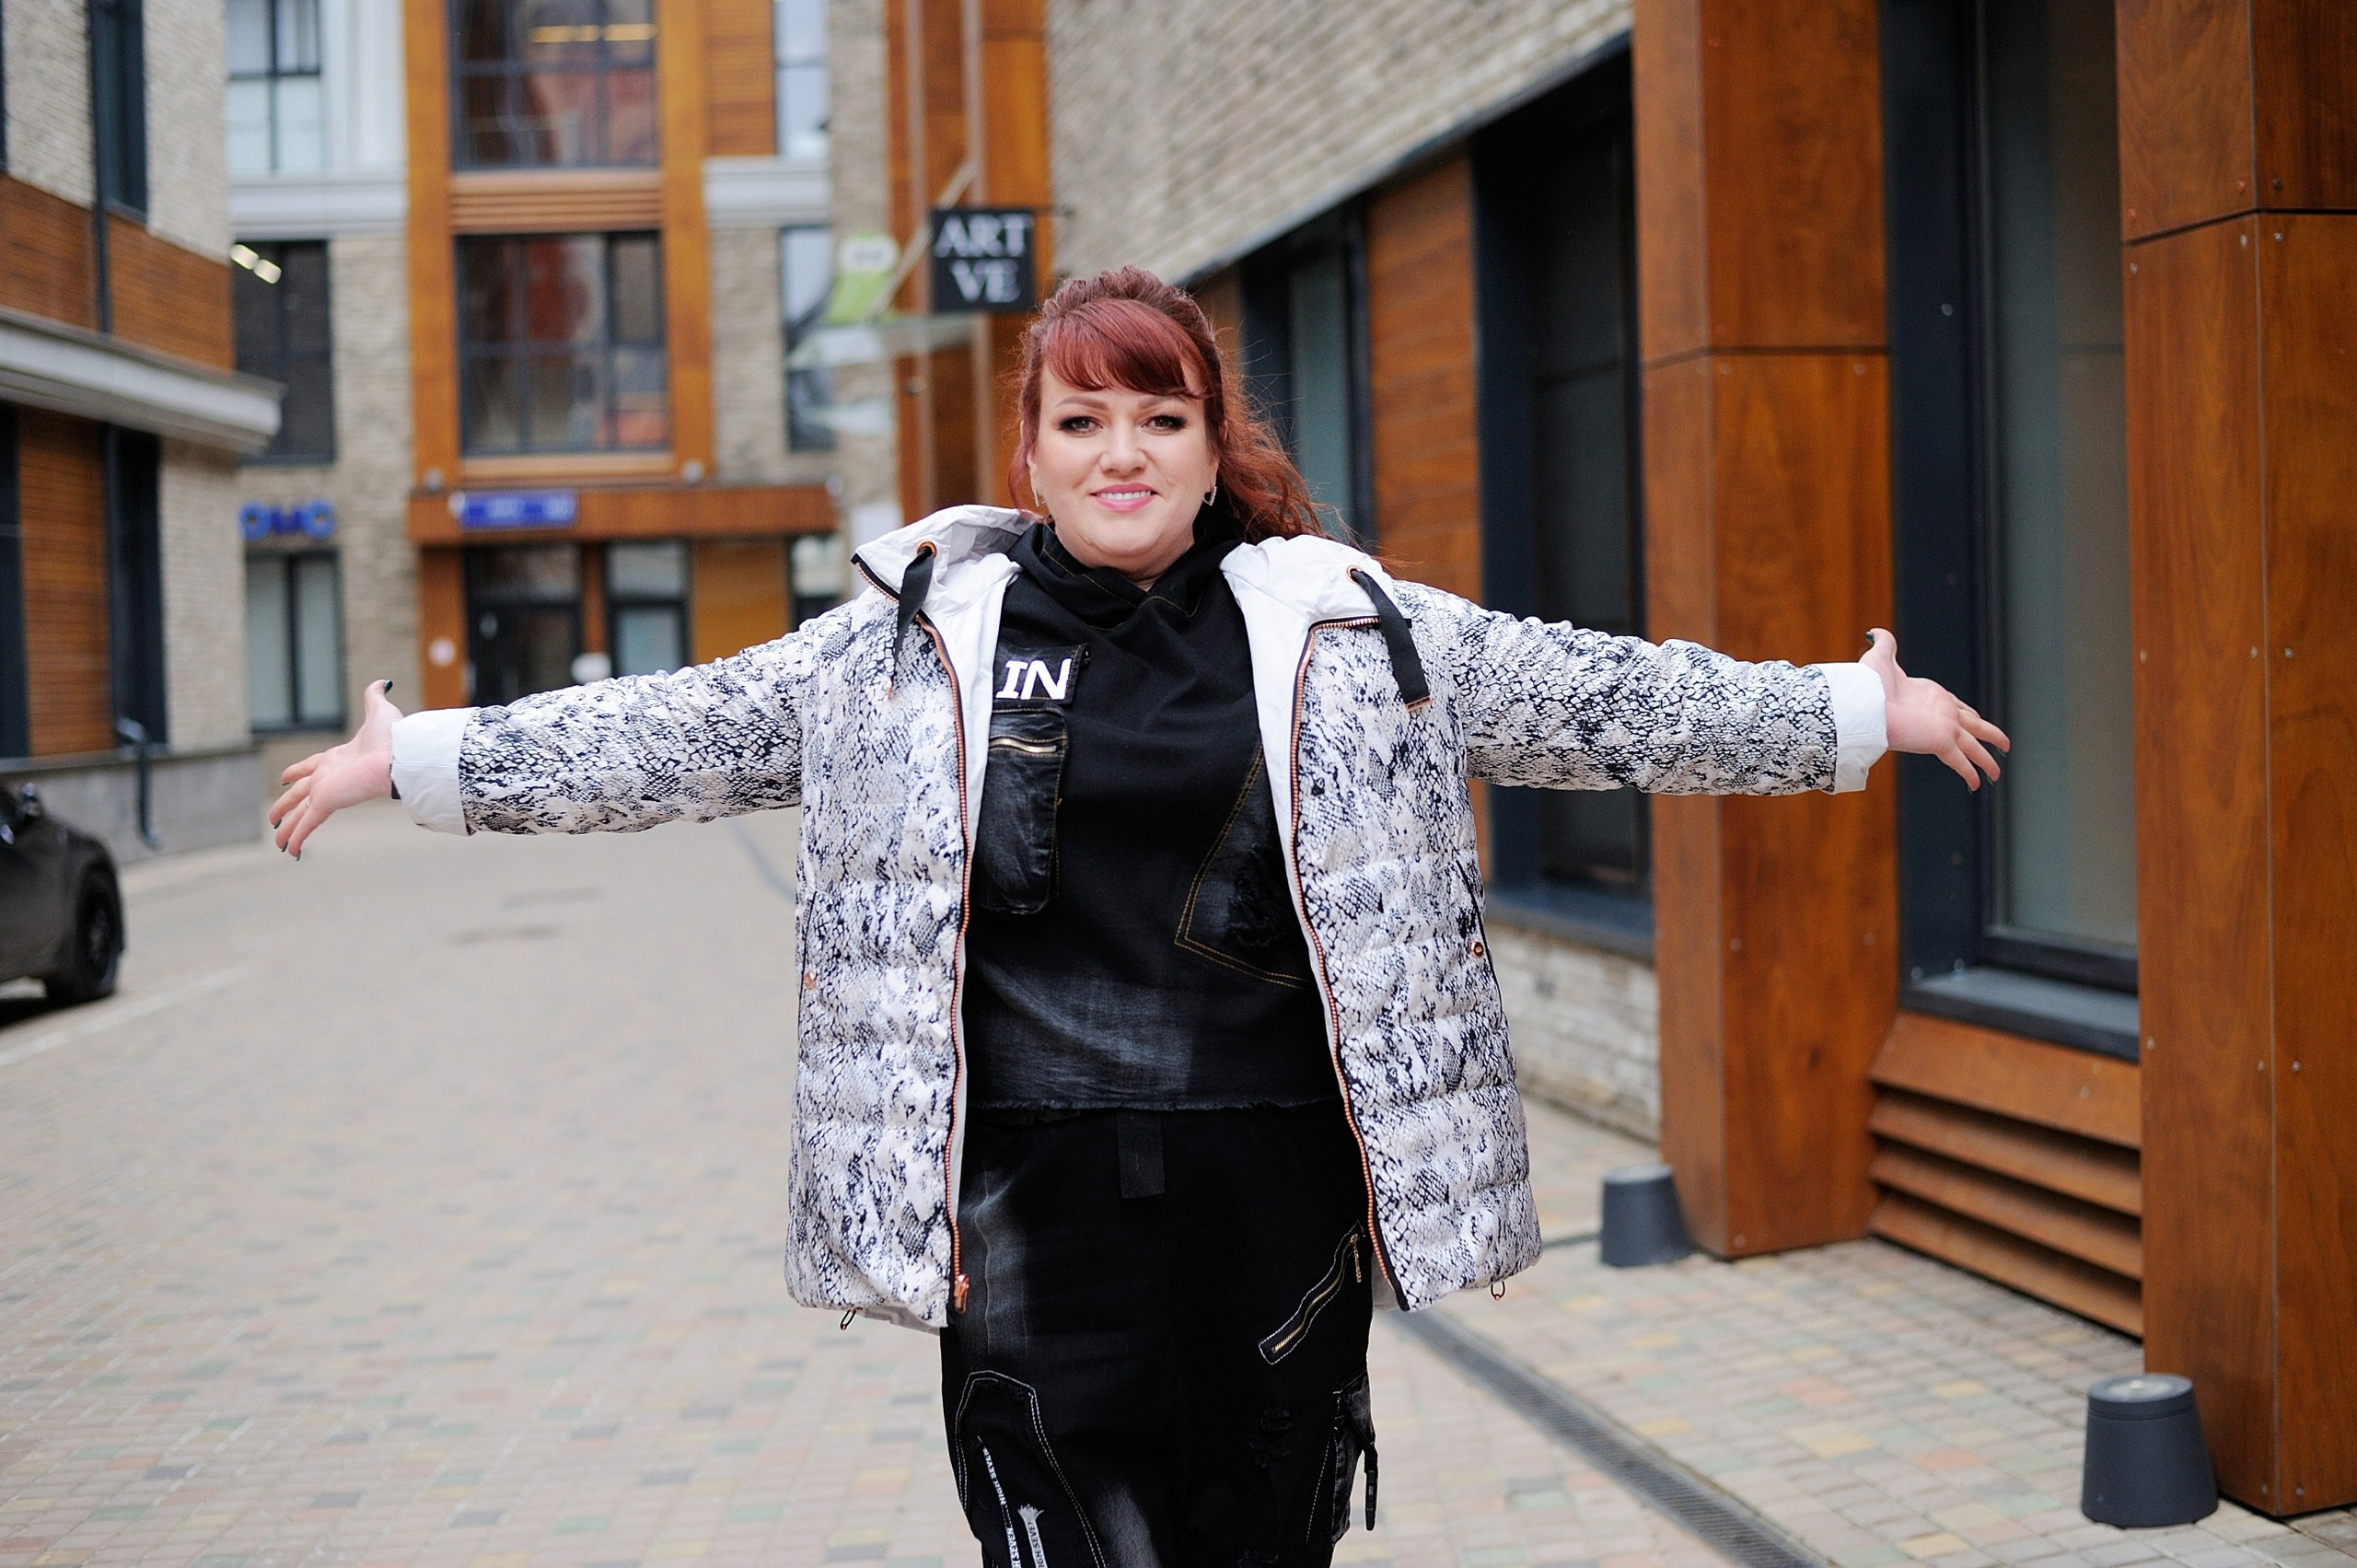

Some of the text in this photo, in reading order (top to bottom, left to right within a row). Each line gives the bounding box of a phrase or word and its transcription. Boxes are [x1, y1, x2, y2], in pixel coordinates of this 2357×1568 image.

[935, 214, 1033, 257] ART
[951, 259, 1021, 302] VE
[995, 657, 1073, 700] IN
[1034, 1551, 1045, 1568] IGH
